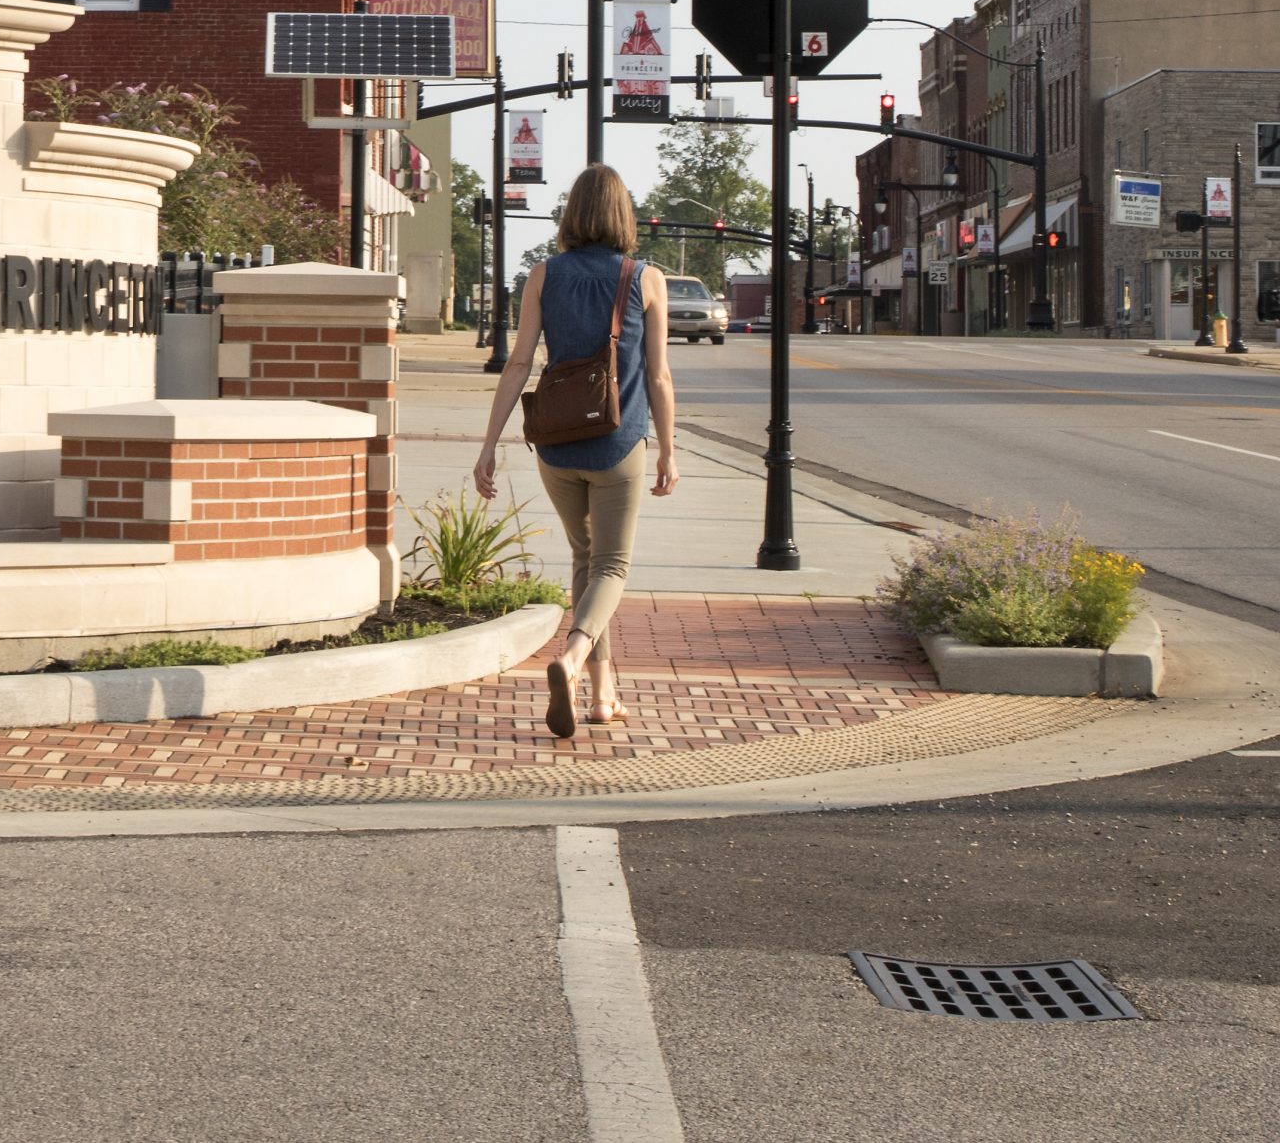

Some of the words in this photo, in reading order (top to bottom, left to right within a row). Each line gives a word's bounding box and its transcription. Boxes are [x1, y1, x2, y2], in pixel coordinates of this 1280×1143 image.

[808, 34, 822, 53] 6
[1162, 250, 1234, 258] INSURNCE
[931, 272, 947, 282] 25
